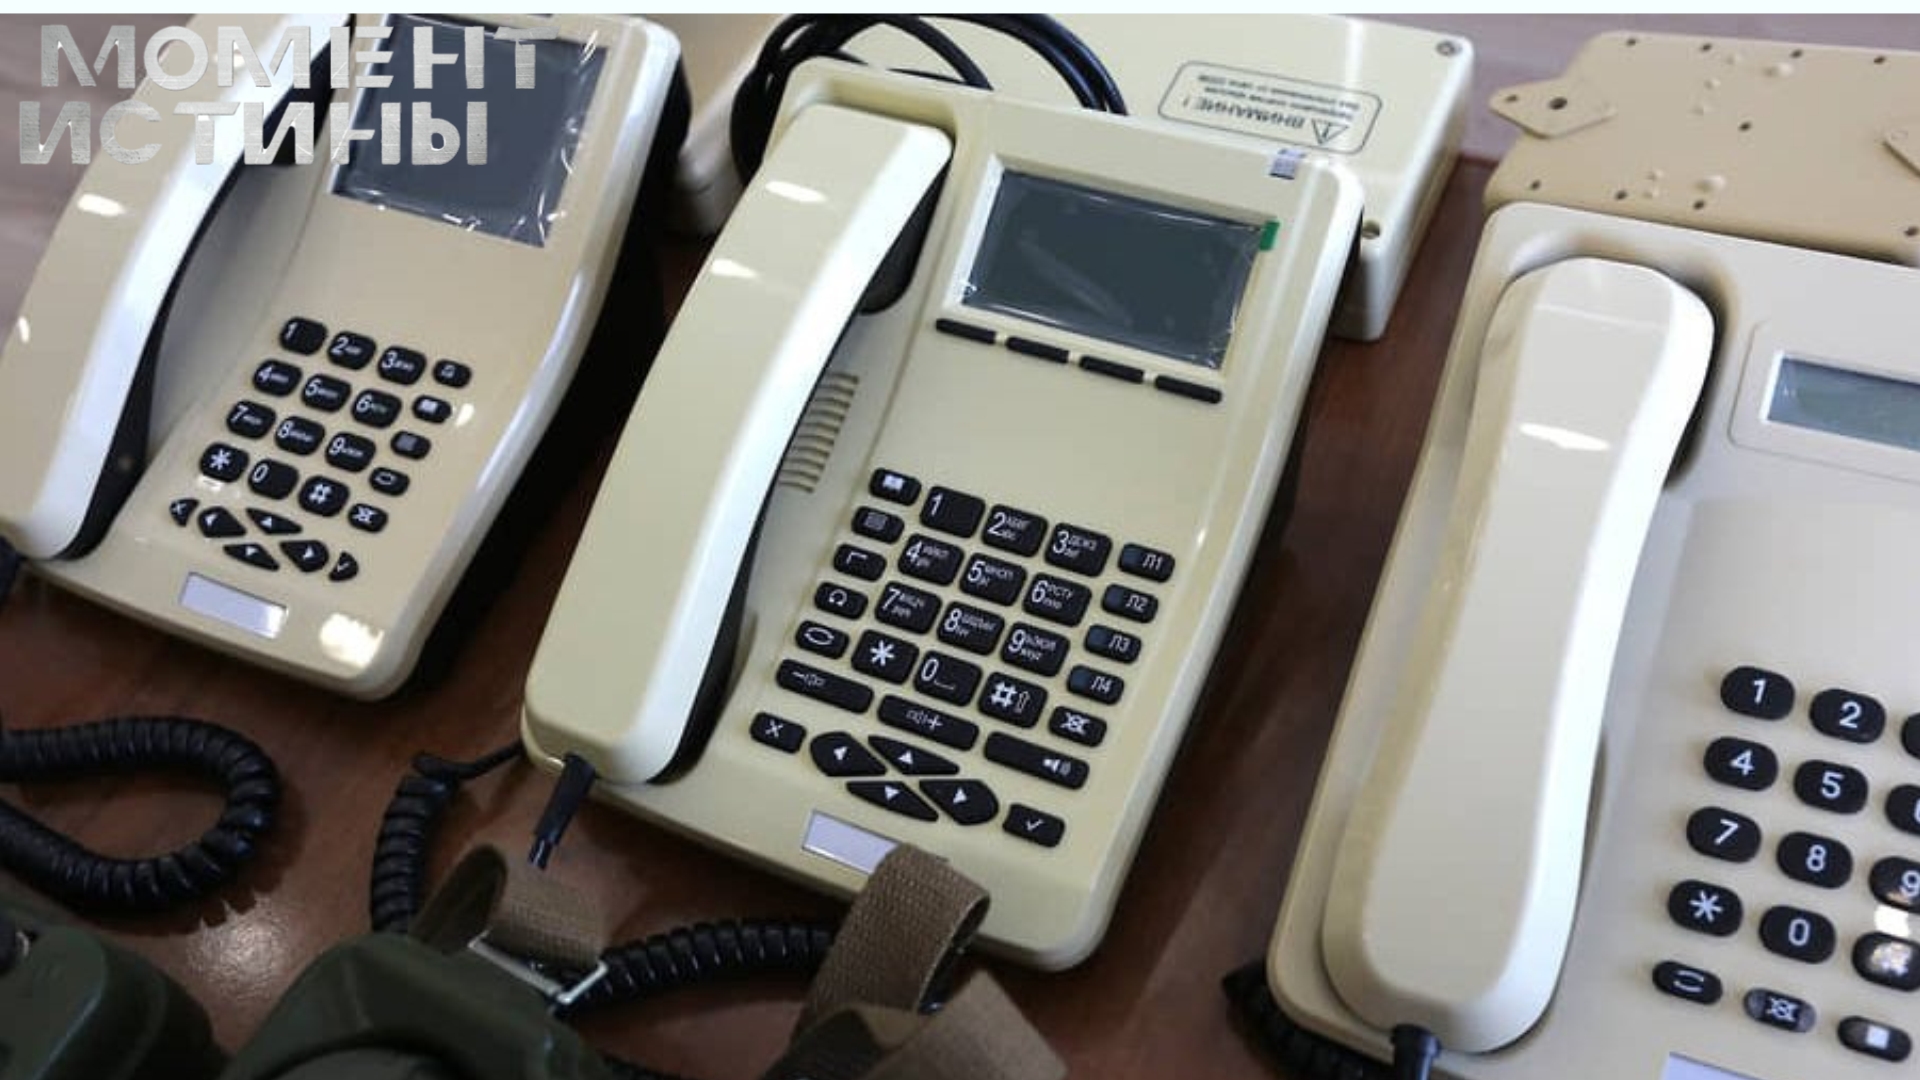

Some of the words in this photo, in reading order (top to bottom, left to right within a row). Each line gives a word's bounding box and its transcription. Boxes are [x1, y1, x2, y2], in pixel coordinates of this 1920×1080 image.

[285, 323, 297, 340] 1
[331, 336, 349, 355] 2
[381, 350, 398, 369] 3
[258, 364, 273, 382] 4
[304, 379, 321, 397] 5
[229, 405, 249, 423] 7
[356, 394, 373, 413] 6
[277, 420, 294, 438] 8
[329, 437, 347, 456] 9
[930, 495, 942, 516] 1
[987, 511, 1006, 536] 2
[905, 541, 923, 563] 4
[1052, 530, 1070, 554] 3
[967, 560, 985, 582] 5
[882, 587, 901, 611] 7
[1031, 580, 1049, 603] 6
[944, 608, 963, 632] 8
[1008, 629, 1027, 653] 9
[920, 657, 940, 682] 0
[1753, 679, 1767, 704] 1
[1839, 702, 1862, 729] 2
[1730, 750, 1754, 775] 4
[1821, 772, 1843, 799] 5
[1714, 819, 1740, 845] 7
[1806, 845, 1827, 872] 8
[1900, 870, 1920, 898] 9
[1788, 918, 1810, 946] 0
